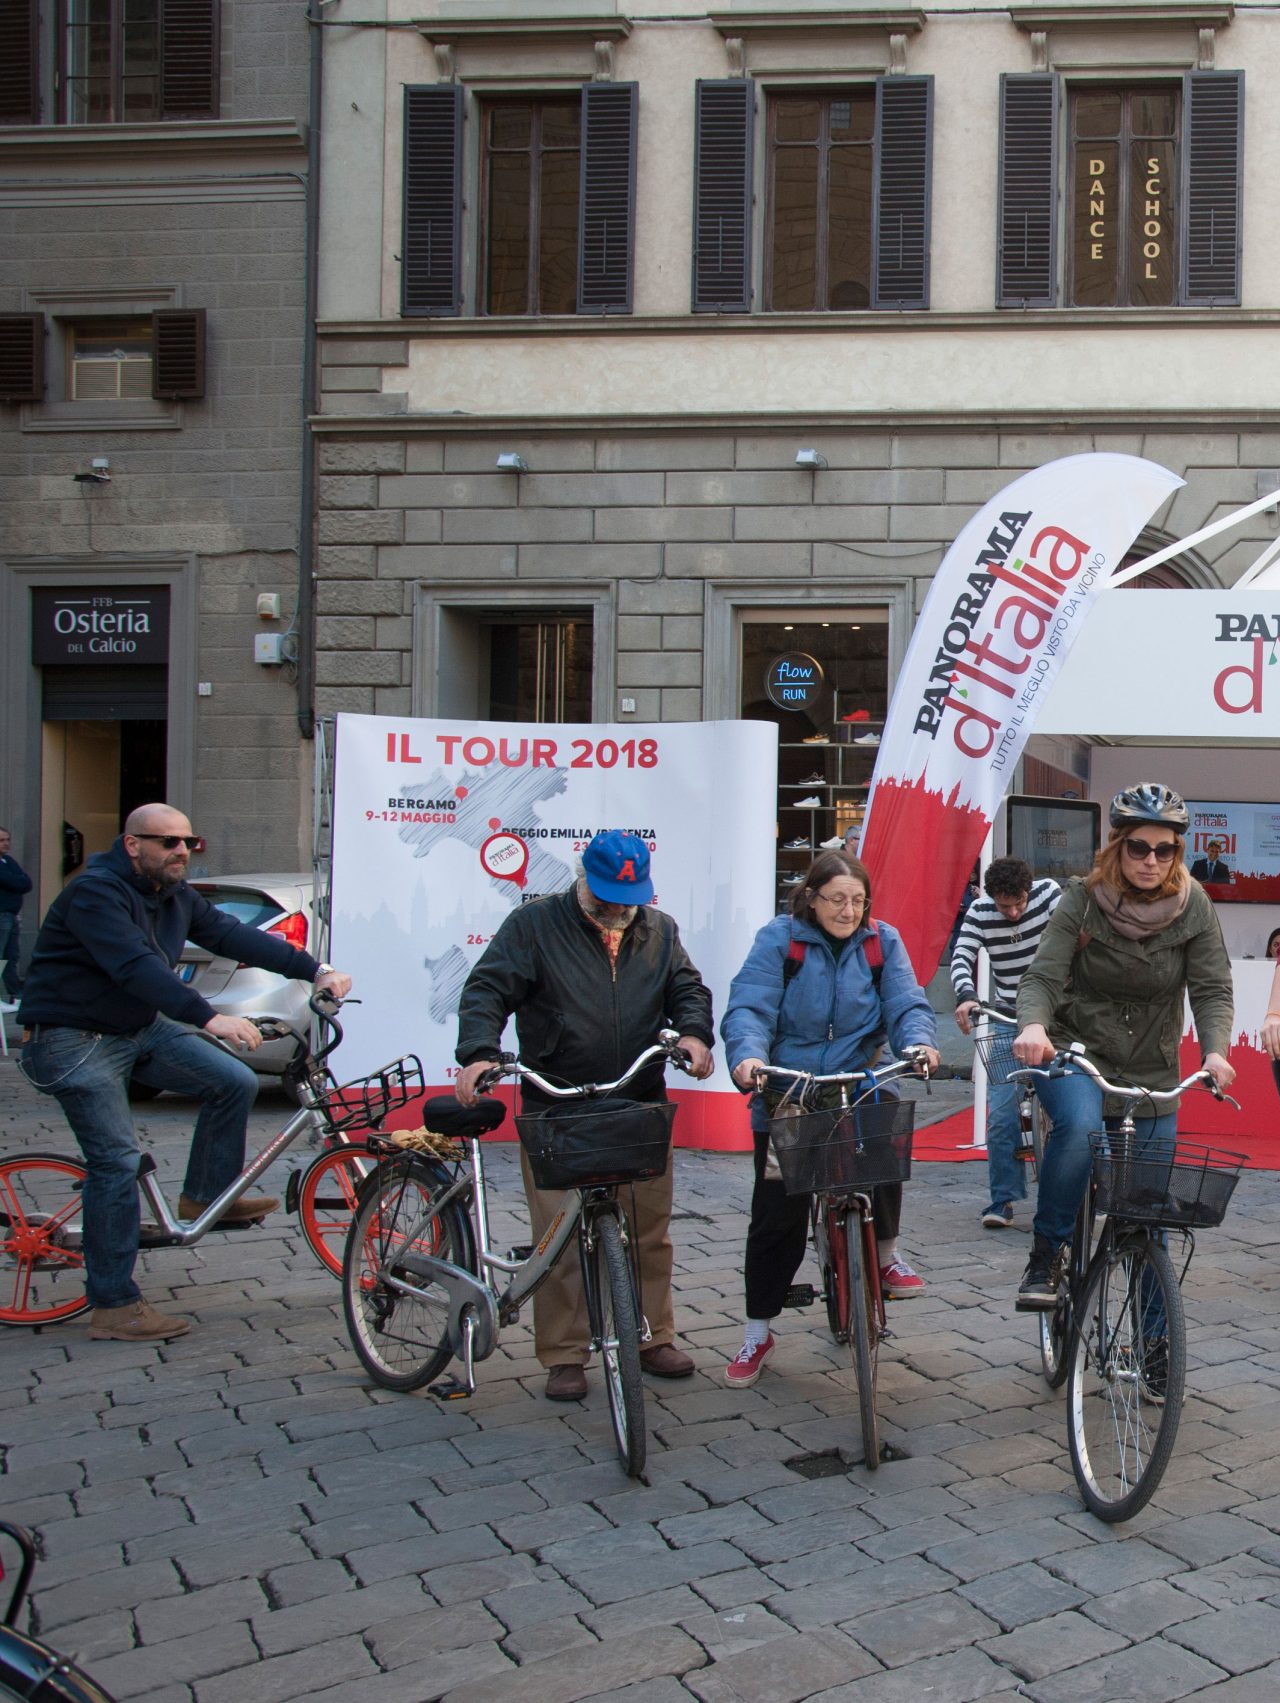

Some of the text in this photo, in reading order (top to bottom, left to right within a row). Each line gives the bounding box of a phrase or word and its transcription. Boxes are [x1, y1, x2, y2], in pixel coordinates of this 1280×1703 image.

[1089, 159, 1105, 259] DANCE
[1143, 158, 1161, 279] SCHOOL
[92, 597, 113, 607] FFB
[54, 608, 151, 634] Osteria
[912, 510, 1033, 741] PANORAMA
[67, 636, 137, 653] DEL Calcio
[943, 525, 1092, 759] d'Italia
[777, 662, 813, 682] flow
[990, 552, 1106, 772] TUTTO IL MEGLIO VISTO DA VICINO
[783, 689, 806, 700] RUN
[386, 732, 659, 769] IL TOUR 2018
[388, 797, 457, 811] BERGAMO
[365, 810, 457, 824] 9-12 MAGGIO
[550, 828, 593, 839] EMILIA
[616, 860, 637, 882] A
